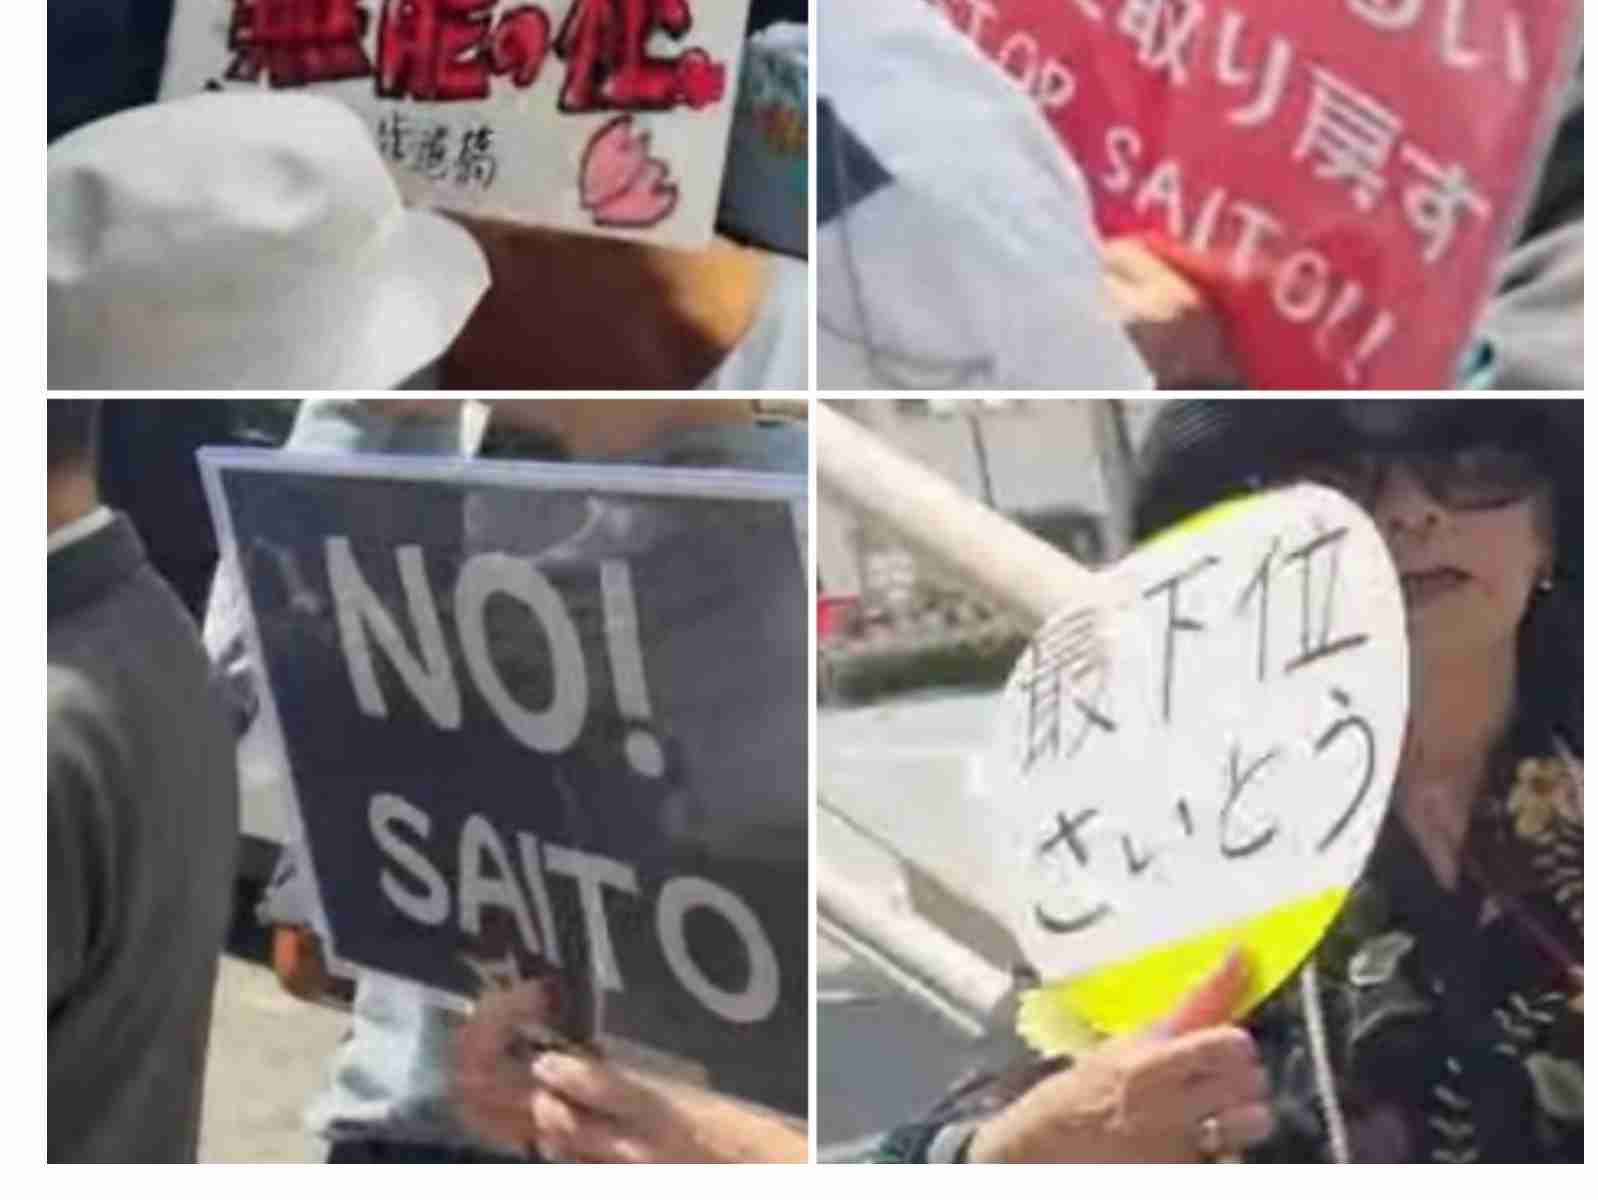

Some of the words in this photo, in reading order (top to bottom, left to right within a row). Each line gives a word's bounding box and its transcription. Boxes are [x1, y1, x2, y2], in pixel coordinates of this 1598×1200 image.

[1101, 126, 1395, 384] SAITO!!
[326, 535, 666, 778] NO!
[1018, 522, 1370, 774] 最下位
[368, 791, 781, 1025] SAITO
[1033, 688, 1377, 933] さいとう
